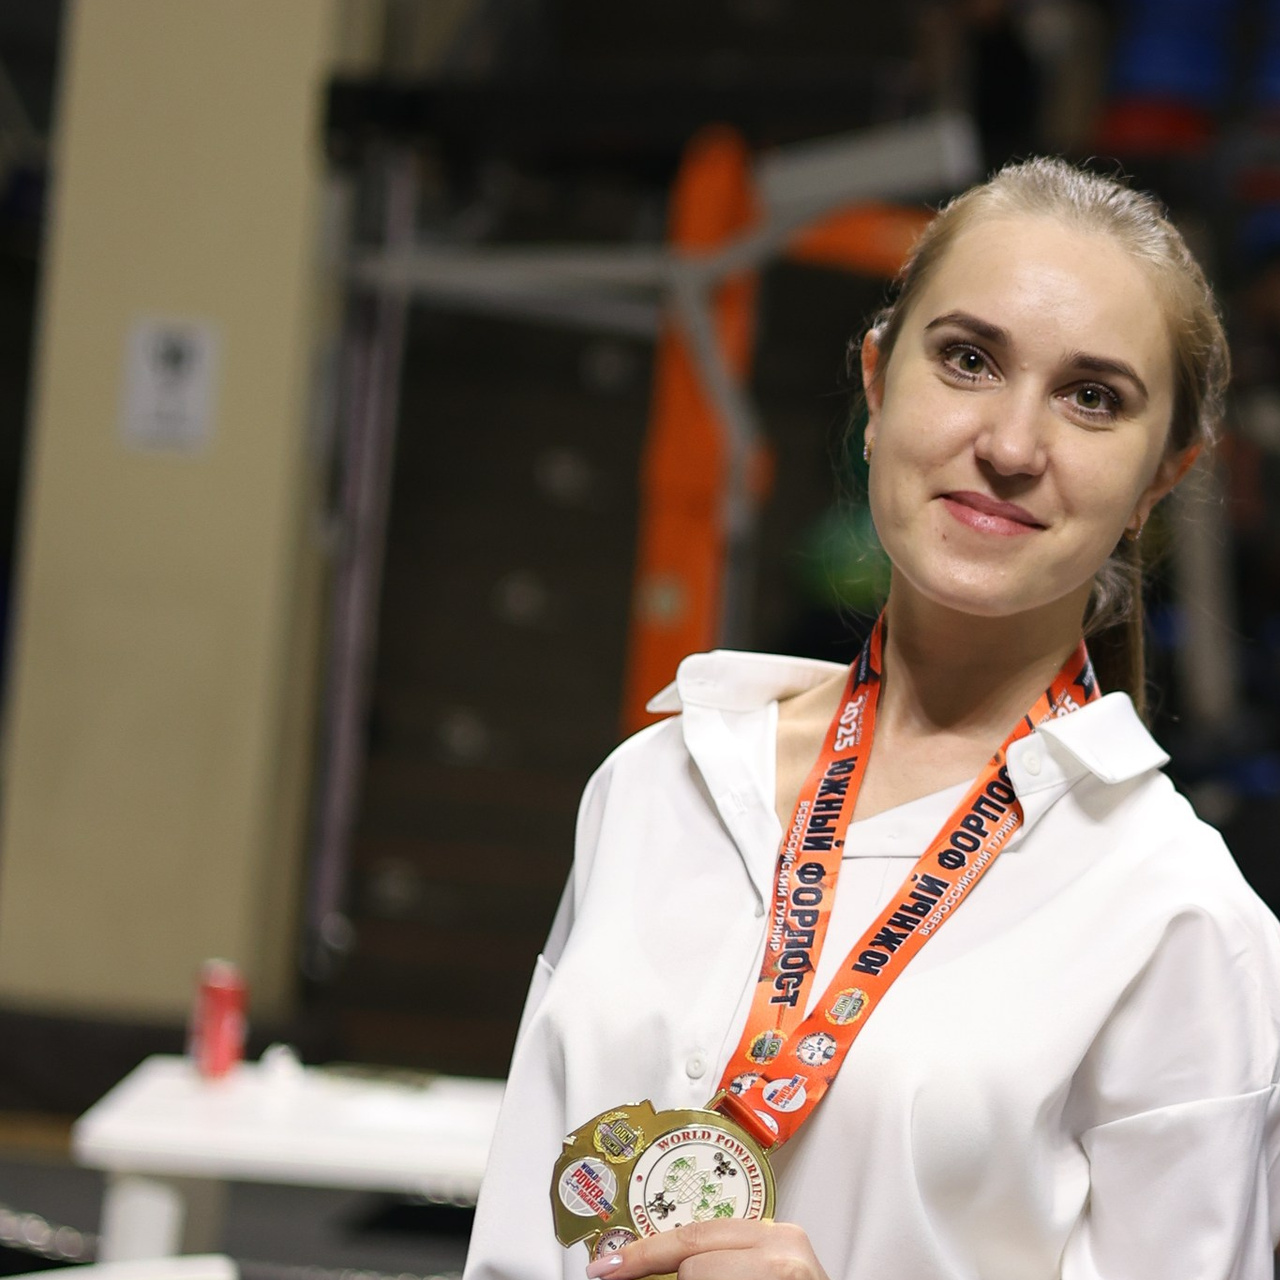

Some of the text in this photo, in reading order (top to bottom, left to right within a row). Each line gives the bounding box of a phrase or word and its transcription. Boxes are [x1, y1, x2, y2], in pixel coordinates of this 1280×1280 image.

[834, 695, 863, 752] 2025
[1056, 694, 1081, 718] 25
[801, 756, 859, 852] ЮЖНЫЙ
[769, 801, 810, 952] ВСЕРОССИЙСКИЙ ТУРНИР
[918, 811, 1020, 936] ВСЕРОССИЙСКИЙ ТУРНИР
[770, 862, 826, 1008] ФОРПОСТ
[851, 873, 950, 976] ЮЖНЫЙ
[603, 1136, 624, 1155] POWER
[613, 1124, 633, 1144] DON
[656, 1130, 712, 1151] WORLD
[572, 1168, 605, 1201] POWER
[580, 1162, 599, 1181] WORLD
